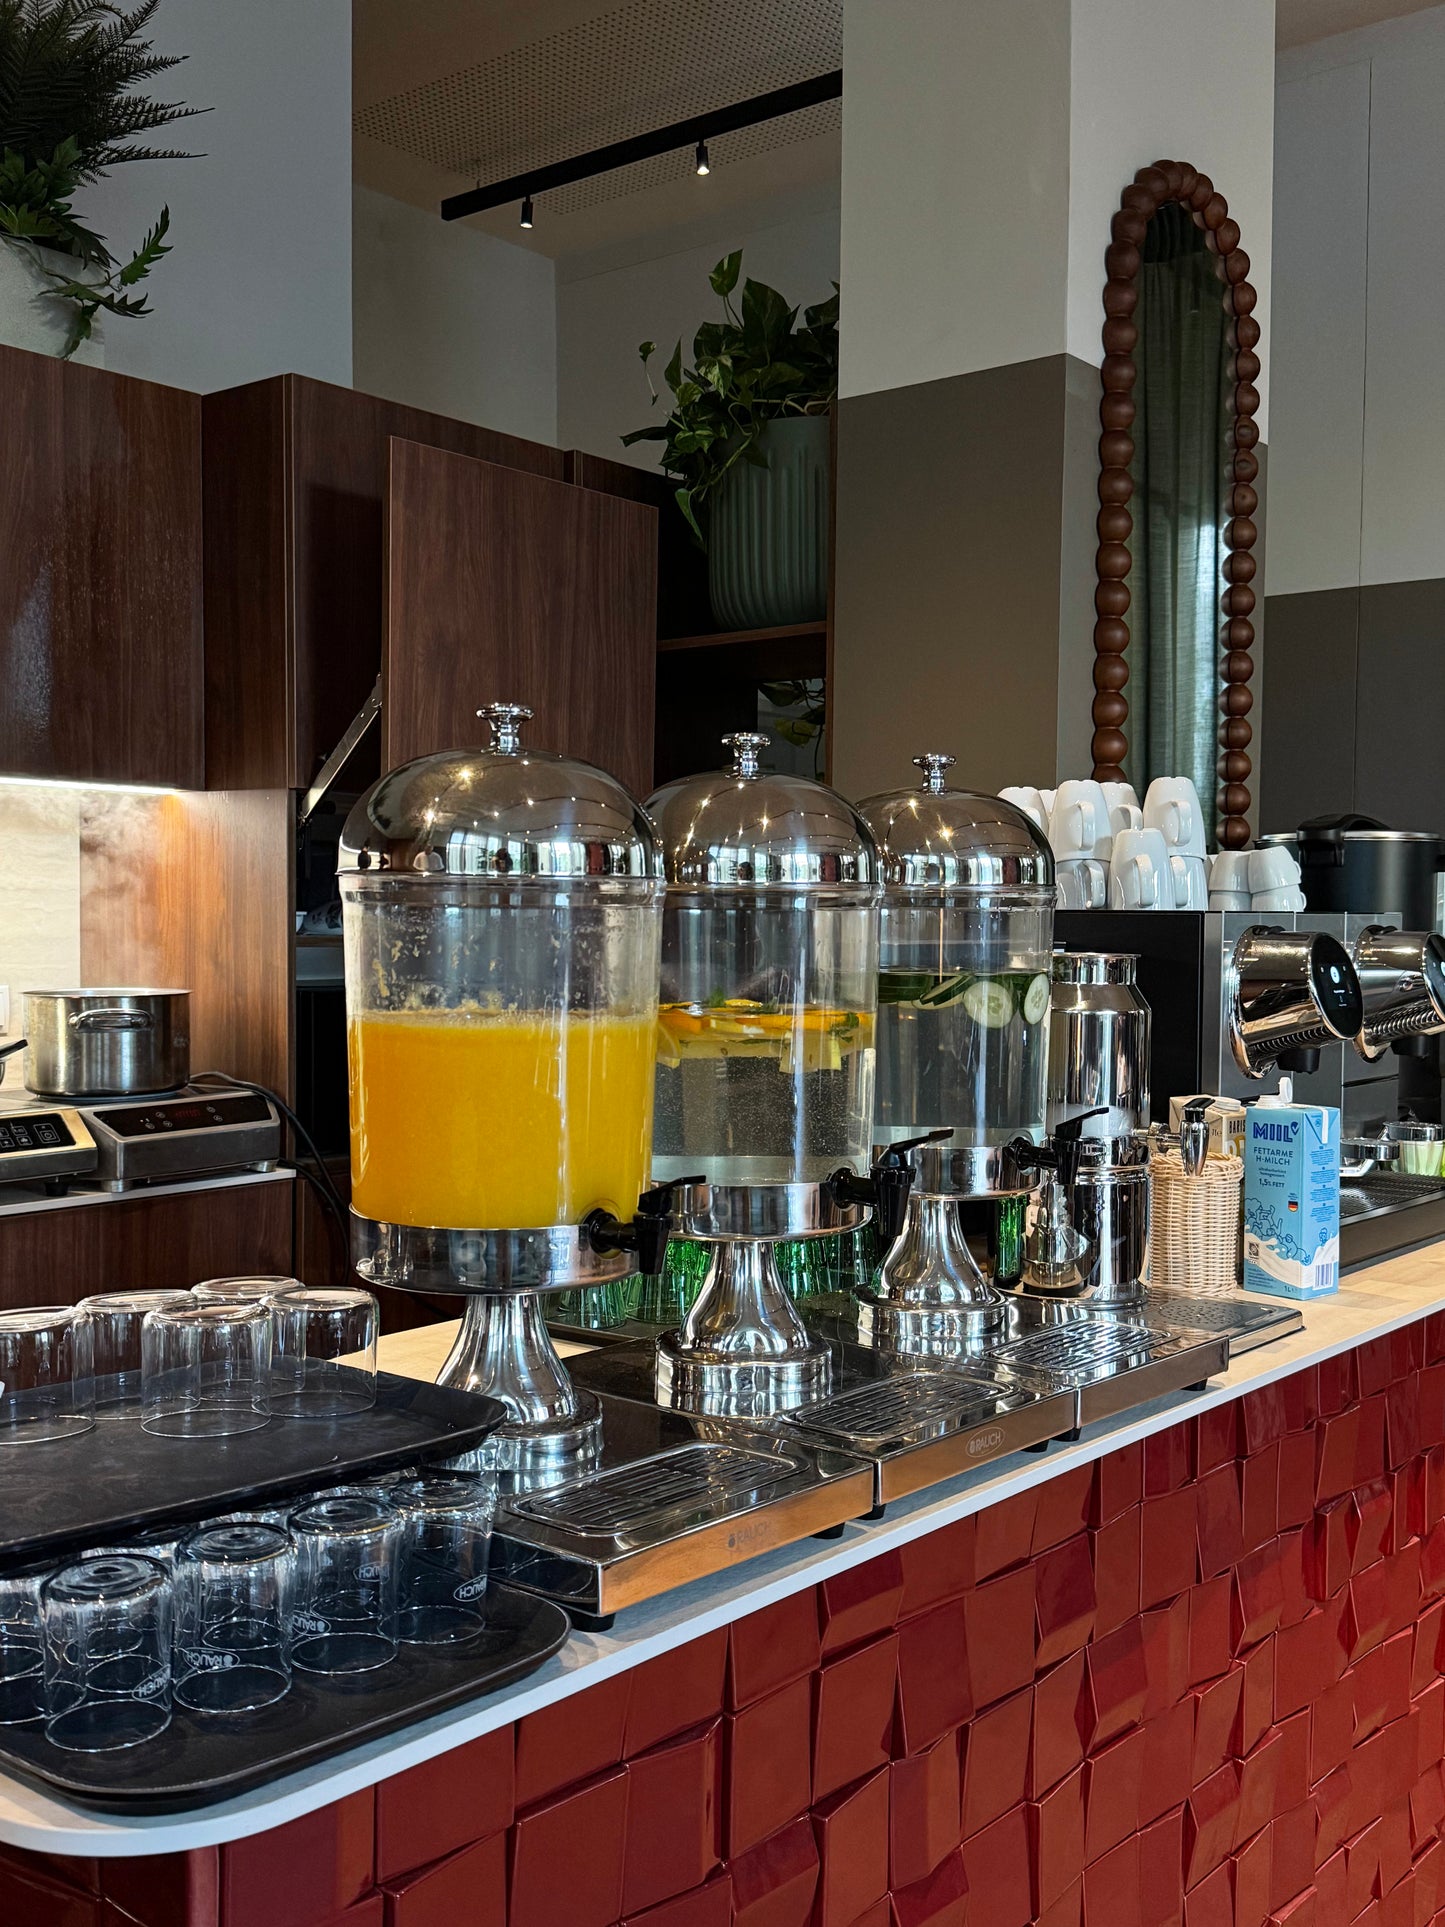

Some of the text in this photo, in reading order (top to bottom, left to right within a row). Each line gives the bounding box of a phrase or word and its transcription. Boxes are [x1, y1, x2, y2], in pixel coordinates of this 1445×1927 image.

[1254, 1146, 1294, 1158] FETTARME
[1256, 1155, 1290, 1166] H-MILCH
[187, 1652, 223, 1668] RAUCH
